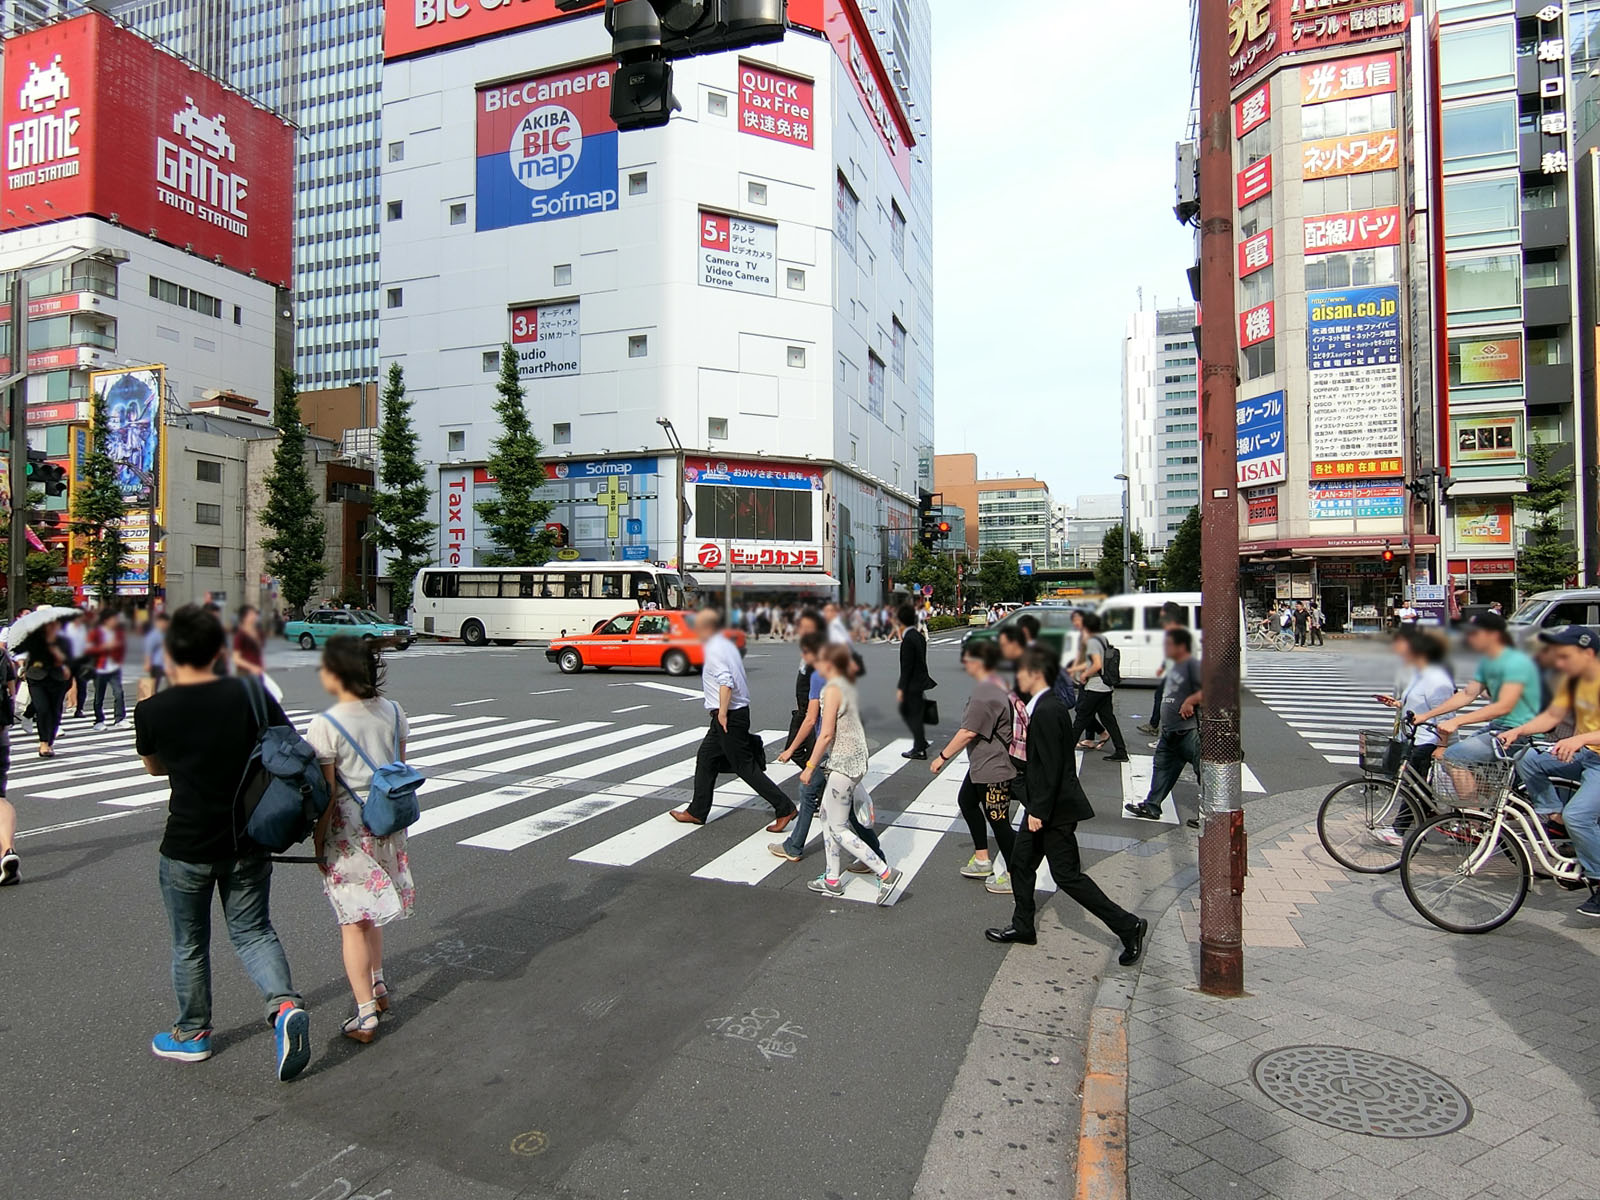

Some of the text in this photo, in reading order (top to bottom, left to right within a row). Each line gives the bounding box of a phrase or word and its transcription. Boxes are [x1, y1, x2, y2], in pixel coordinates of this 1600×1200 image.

[485, 70, 610, 113] BicCamera
[743, 72, 798, 100] QUICK
[742, 88, 809, 119] Tax Free
[522, 110, 570, 132] AKIBA
[743, 109, 808, 142] 快速免税
[523, 125, 571, 158] BIC
[1304, 136, 1396, 173] ネットワーク
[8, 160, 79, 190] TAITO STATION
[518, 153, 575, 180] map
[157, 187, 248, 237] TAITO STATION
[531, 189, 616, 217] Sofmap
[704, 220, 727, 243] 5F
[732, 222, 756, 234] カメラ
[1304, 214, 1396, 249] 配線パーツ
[732, 234, 755, 246] テレビ
[705, 254, 758, 270] Camera TV
[732, 246, 773, 260] ビデオカメラ
[705, 274, 733, 287] Drone
[706, 264, 770, 283] Video Camera
[540, 308, 572, 319] オーディオ
[1312, 298, 1396, 321] aisan.co.jp
[514, 316, 536, 337] 3F
[540, 319, 578, 330] スマートフォン
[540, 329, 577, 341] SIMカード
[518, 348, 546, 360] udio
[519, 361, 577, 375] martPhone
[586, 462, 632, 475] Sofmap
[1315, 464, 1333, 475] 各社
[1336, 463, 1354, 474] 特約
[1358, 462, 1376, 472] 在庫
[449, 476, 466, 568] Tax Fre
[730, 548, 818, 565] ビックカメラ
